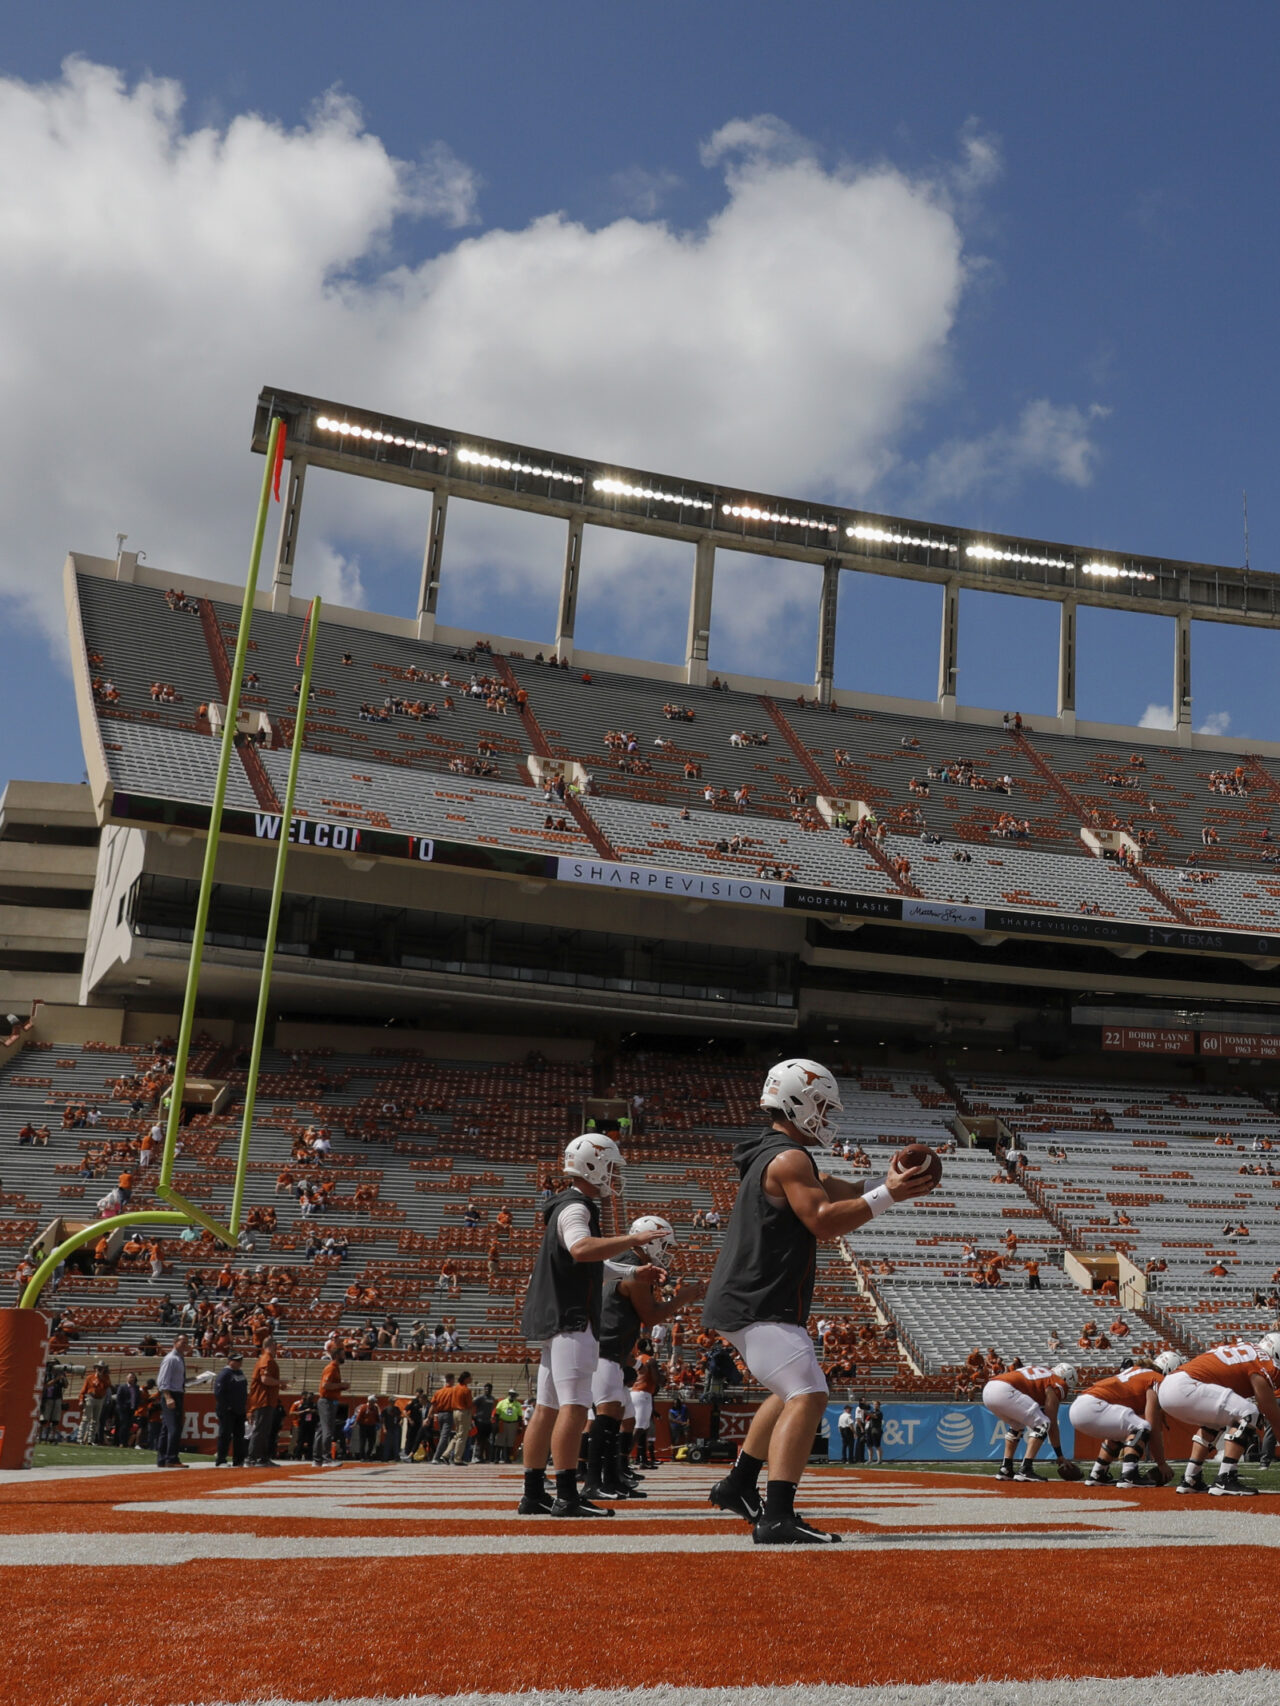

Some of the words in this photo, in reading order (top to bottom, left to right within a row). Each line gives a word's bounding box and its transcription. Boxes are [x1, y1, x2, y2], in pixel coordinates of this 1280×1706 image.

[574, 864, 772, 901] SHARPEVISION
[798, 895, 848, 908] MODERN
[855, 901, 890, 913] LASIK
[1179, 933, 1223, 948] TEXAS
[1105, 1032, 1121, 1045] 22
[1128, 1031, 1158, 1041] BOBBY
[1160, 1033, 1190, 1042] LAYNE
[1224, 1036, 1257, 1046] TOMMY
[1138, 1041, 1155, 1049] 1944
[1164, 1042, 1181, 1050] 1947
[1203, 1038, 1218, 1050] 60
[1235, 1046, 1251, 1054] 1963
[1260, 1047, 1277, 1056] 1965
